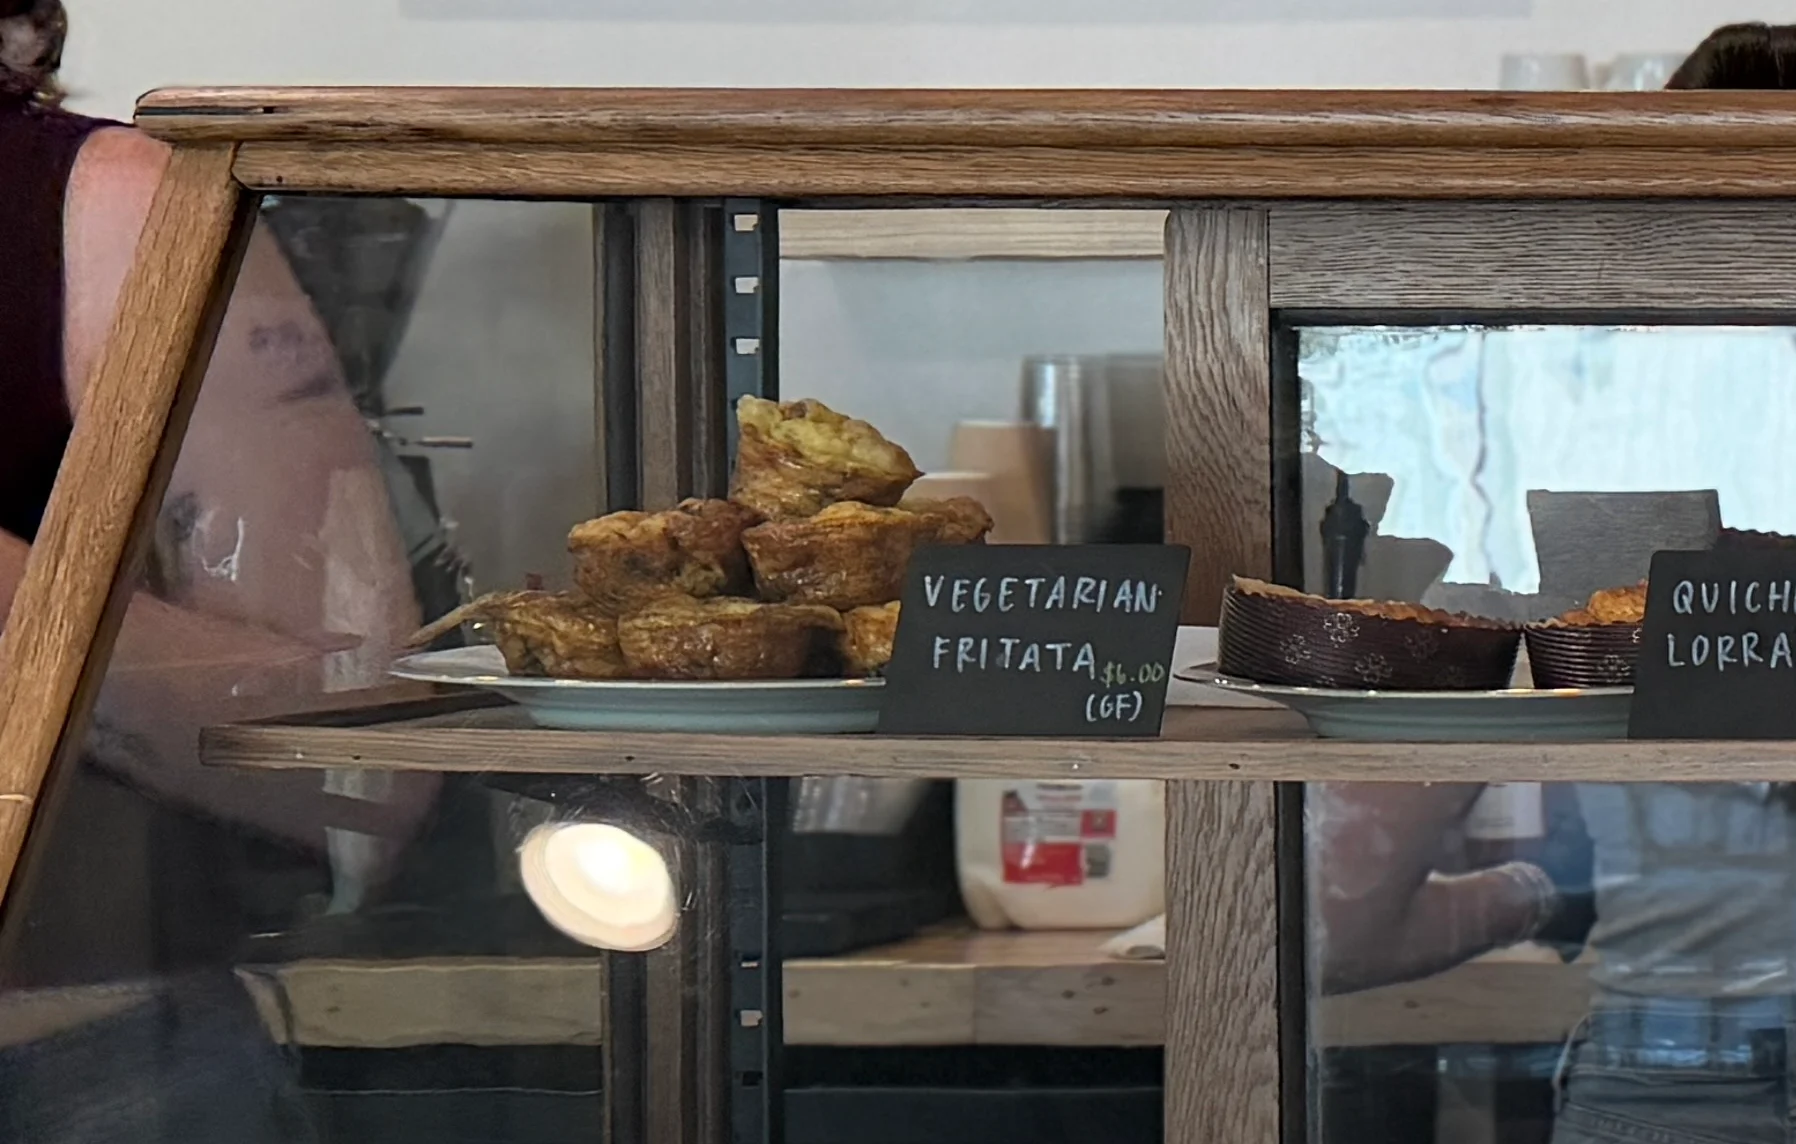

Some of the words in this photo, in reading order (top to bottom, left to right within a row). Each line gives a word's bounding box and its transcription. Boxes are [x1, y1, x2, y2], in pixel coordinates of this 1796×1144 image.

[924, 575, 1157, 614] VEGETARIAN
[932, 636, 1095, 681] FRITATA
[1101, 660, 1165, 689] $6.00
[1085, 690, 1143, 722] (GF)
